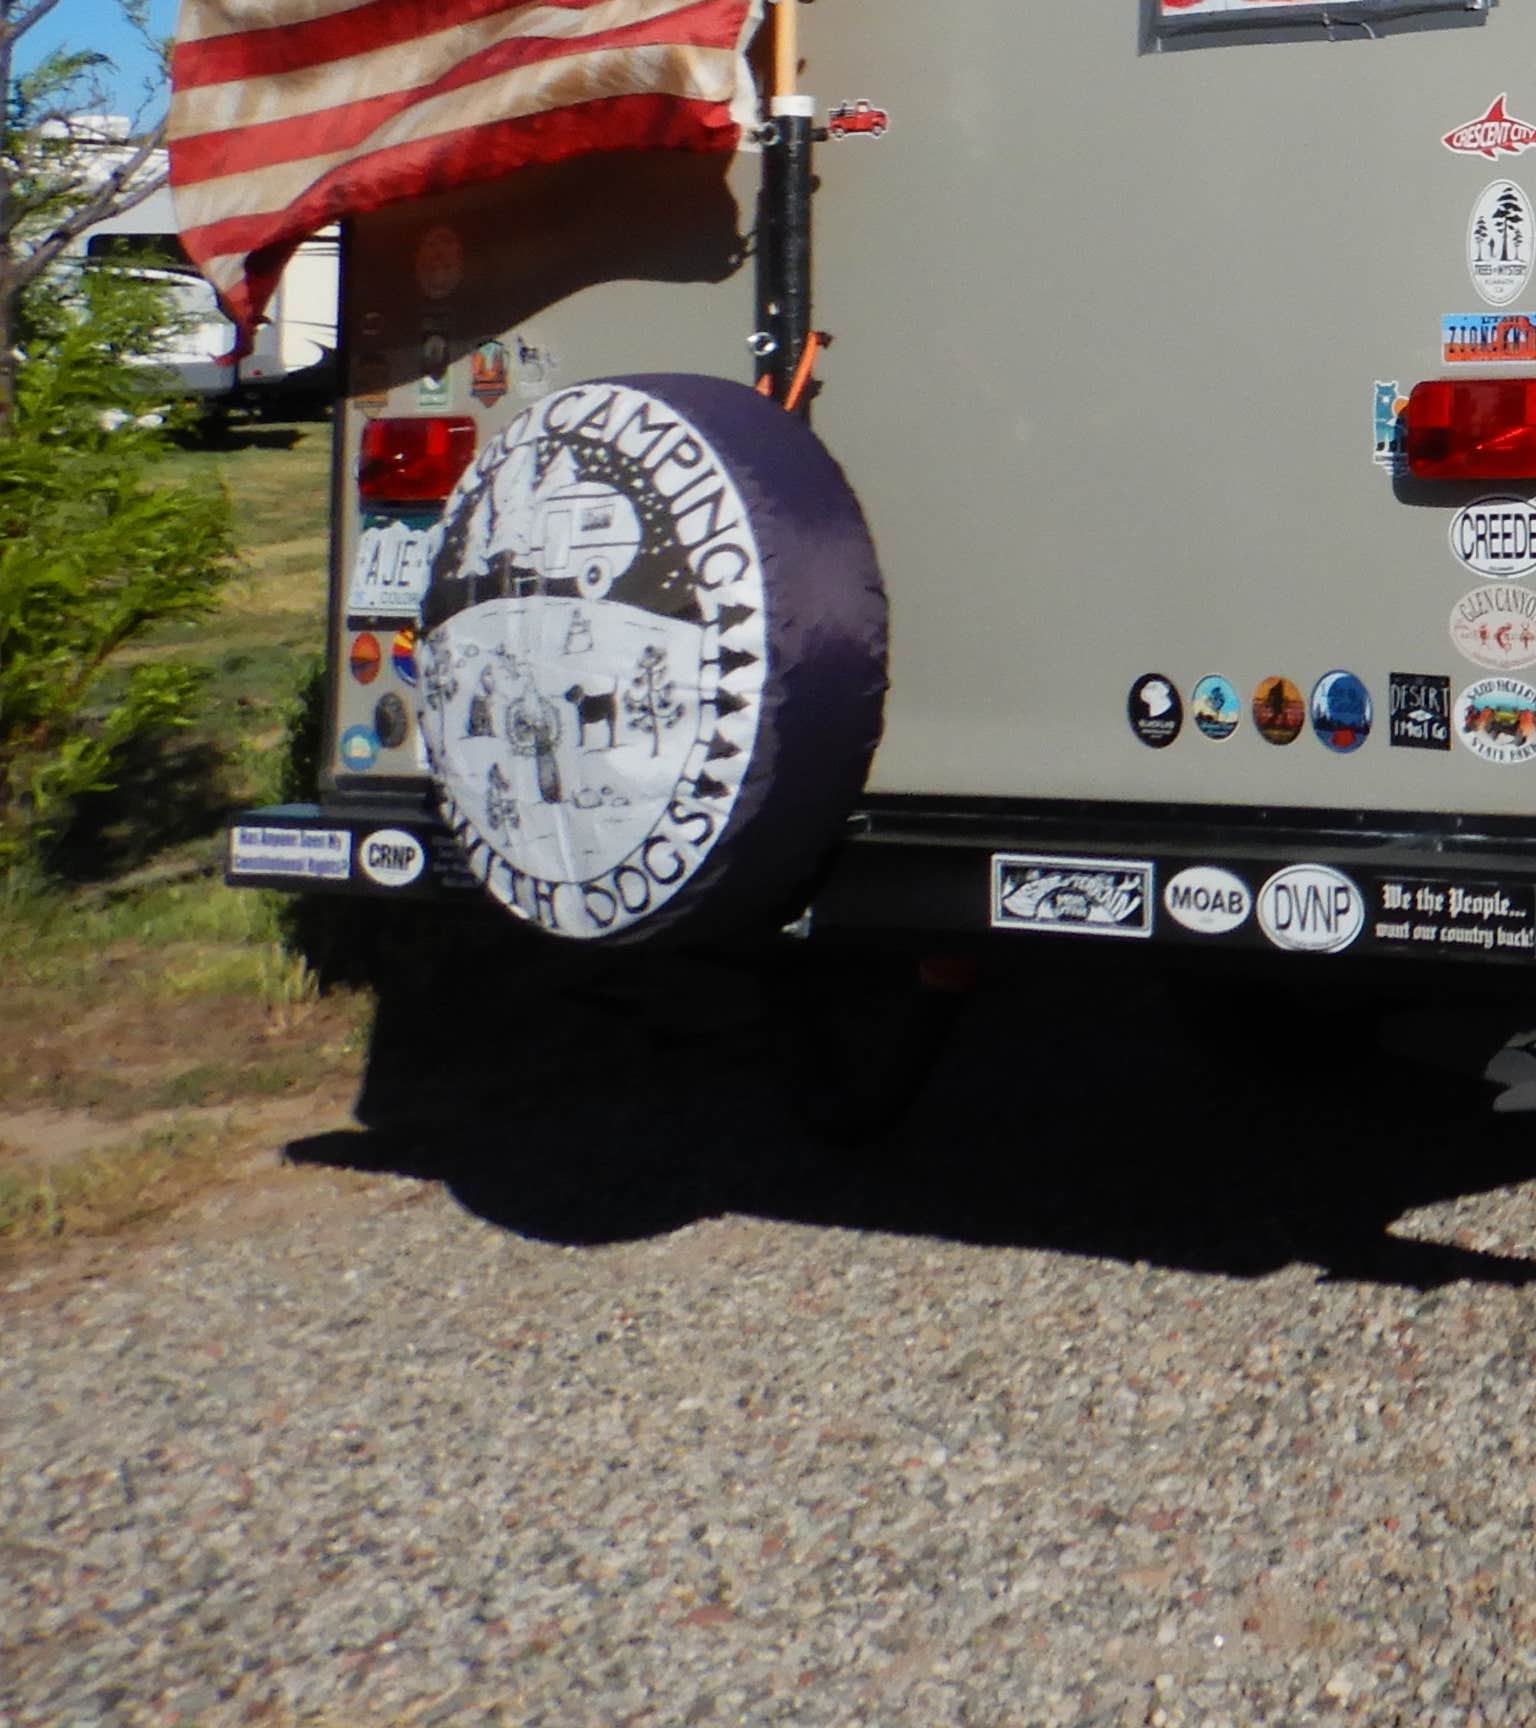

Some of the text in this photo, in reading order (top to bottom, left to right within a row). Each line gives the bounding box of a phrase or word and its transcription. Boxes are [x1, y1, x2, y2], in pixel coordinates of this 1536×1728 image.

[1452, 121, 1512, 148] CRESCENT
[543, 389, 751, 592] CAMPING
[1390, 683, 1450, 717] DESERT
[580, 799, 714, 929] DOGS
[1171, 886, 1244, 915] MOAB
[1274, 883, 1351, 934] DVNP
[1383, 883, 1413, 911] We
[1416, 886, 1443, 917] the
